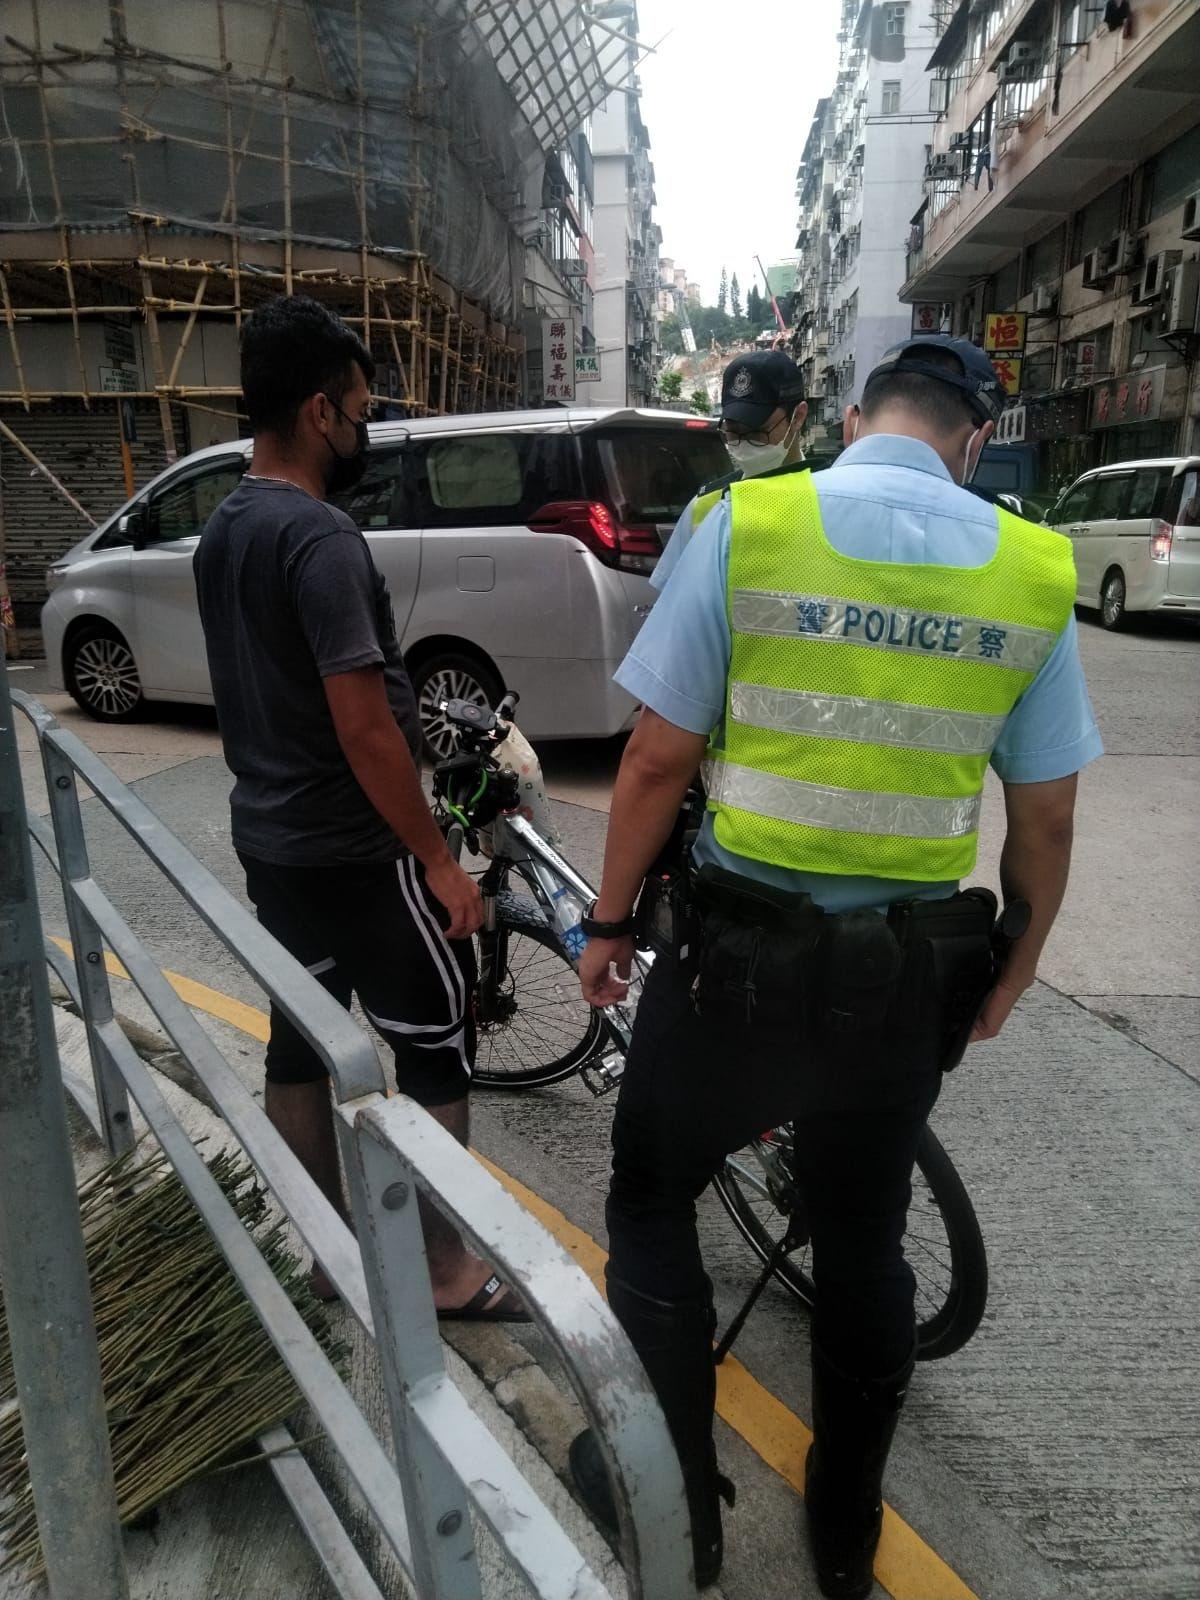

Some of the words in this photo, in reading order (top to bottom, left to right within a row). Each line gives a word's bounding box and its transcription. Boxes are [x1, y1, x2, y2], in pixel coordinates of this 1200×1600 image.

[797, 600, 827, 633] 警
[843, 605, 962, 652] POLICE
[978, 625, 1007, 658] 察
